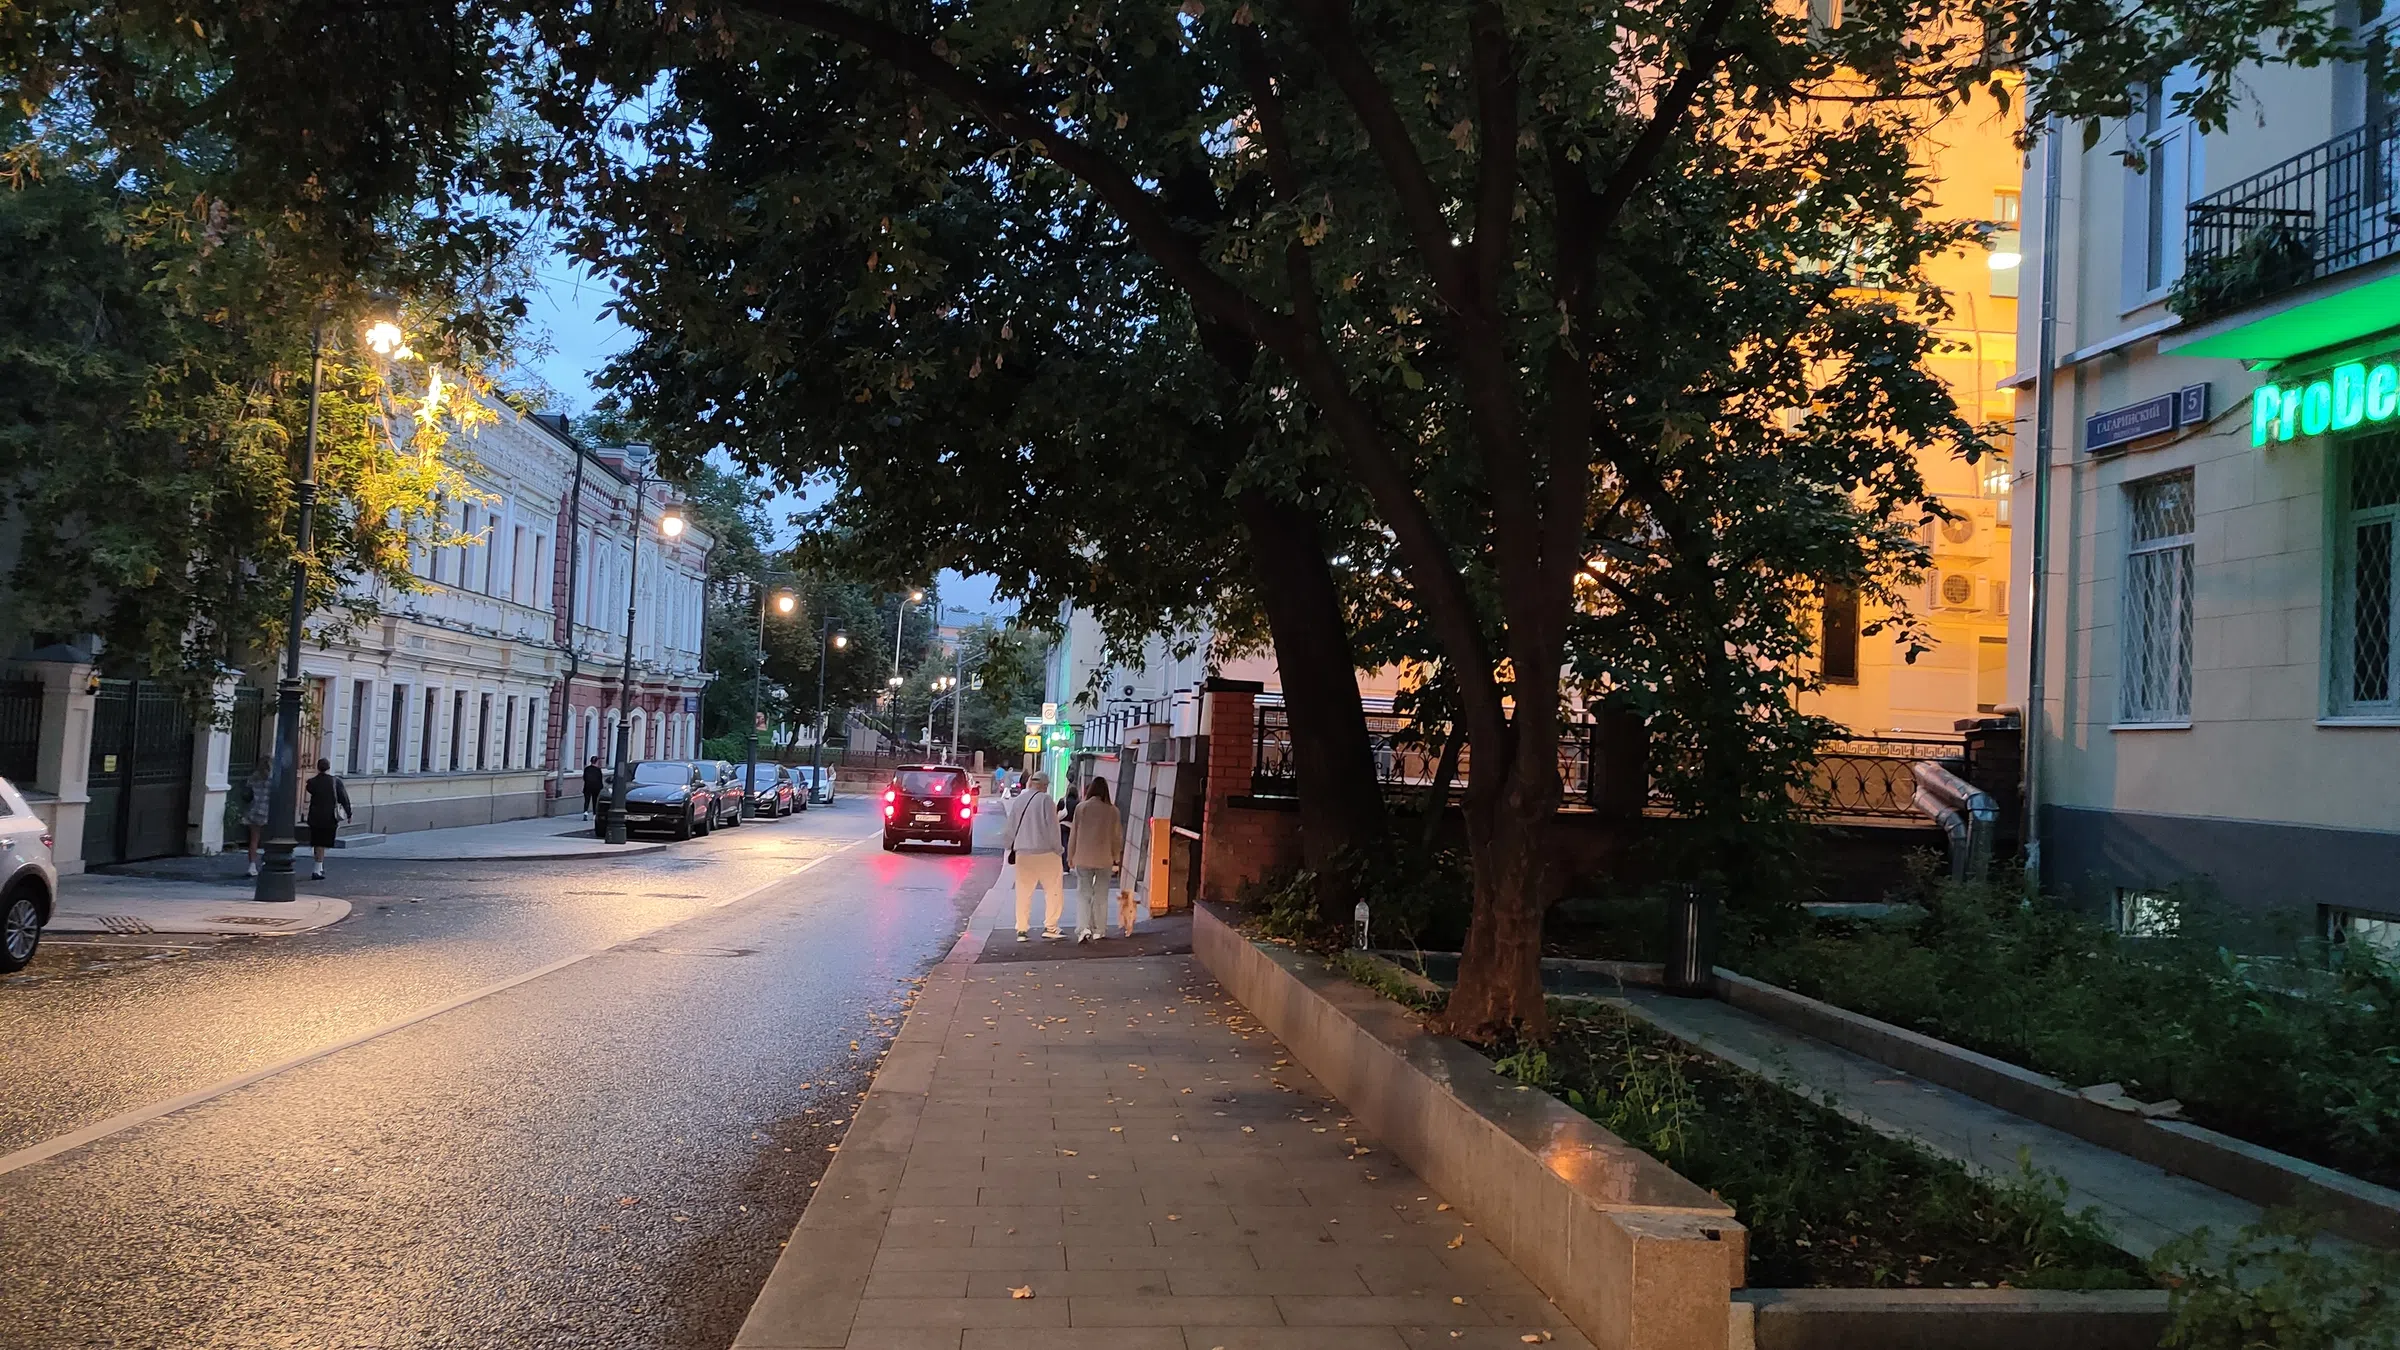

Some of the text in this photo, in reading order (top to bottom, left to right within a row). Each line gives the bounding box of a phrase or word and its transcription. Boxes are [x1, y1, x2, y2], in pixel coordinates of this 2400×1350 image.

[2188, 391, 2198, 411] 5
[2252, 362, 2400, 447] ProDe
[2096, 403, 2160, 435] ГАГАРИНСКИЙ
